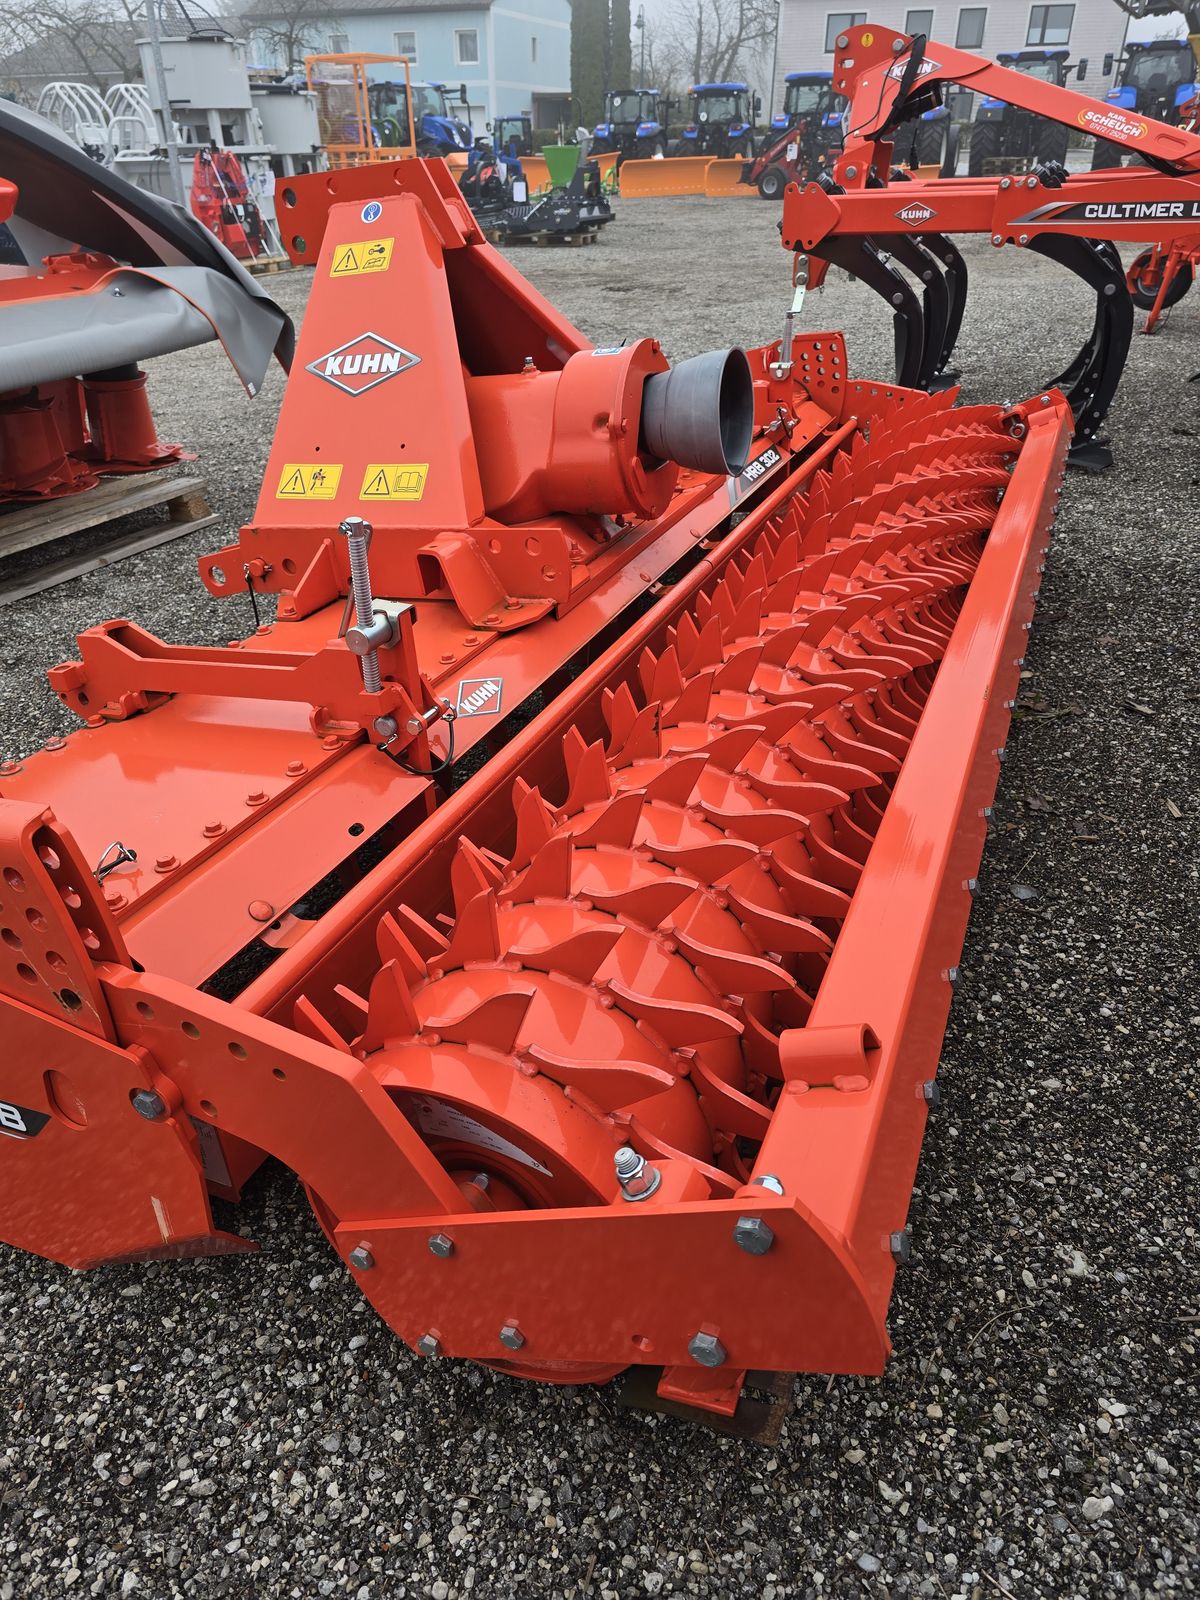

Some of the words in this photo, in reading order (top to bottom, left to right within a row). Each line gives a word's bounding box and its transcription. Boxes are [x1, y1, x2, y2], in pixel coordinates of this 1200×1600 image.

[1085, 111, 1142, 137] SCHEUCH
[1107, 112, 1127, 122] KARL
[901, 210, 931, 219] KUHN
[1085, 203, 1184, 218] CULTIMER
[324, 352, 401, 376] KUHN
[742, 461, 766, 481] HRB
[758, 449, 780, 468] 302
[460, 680, 499, 714] KUHN
